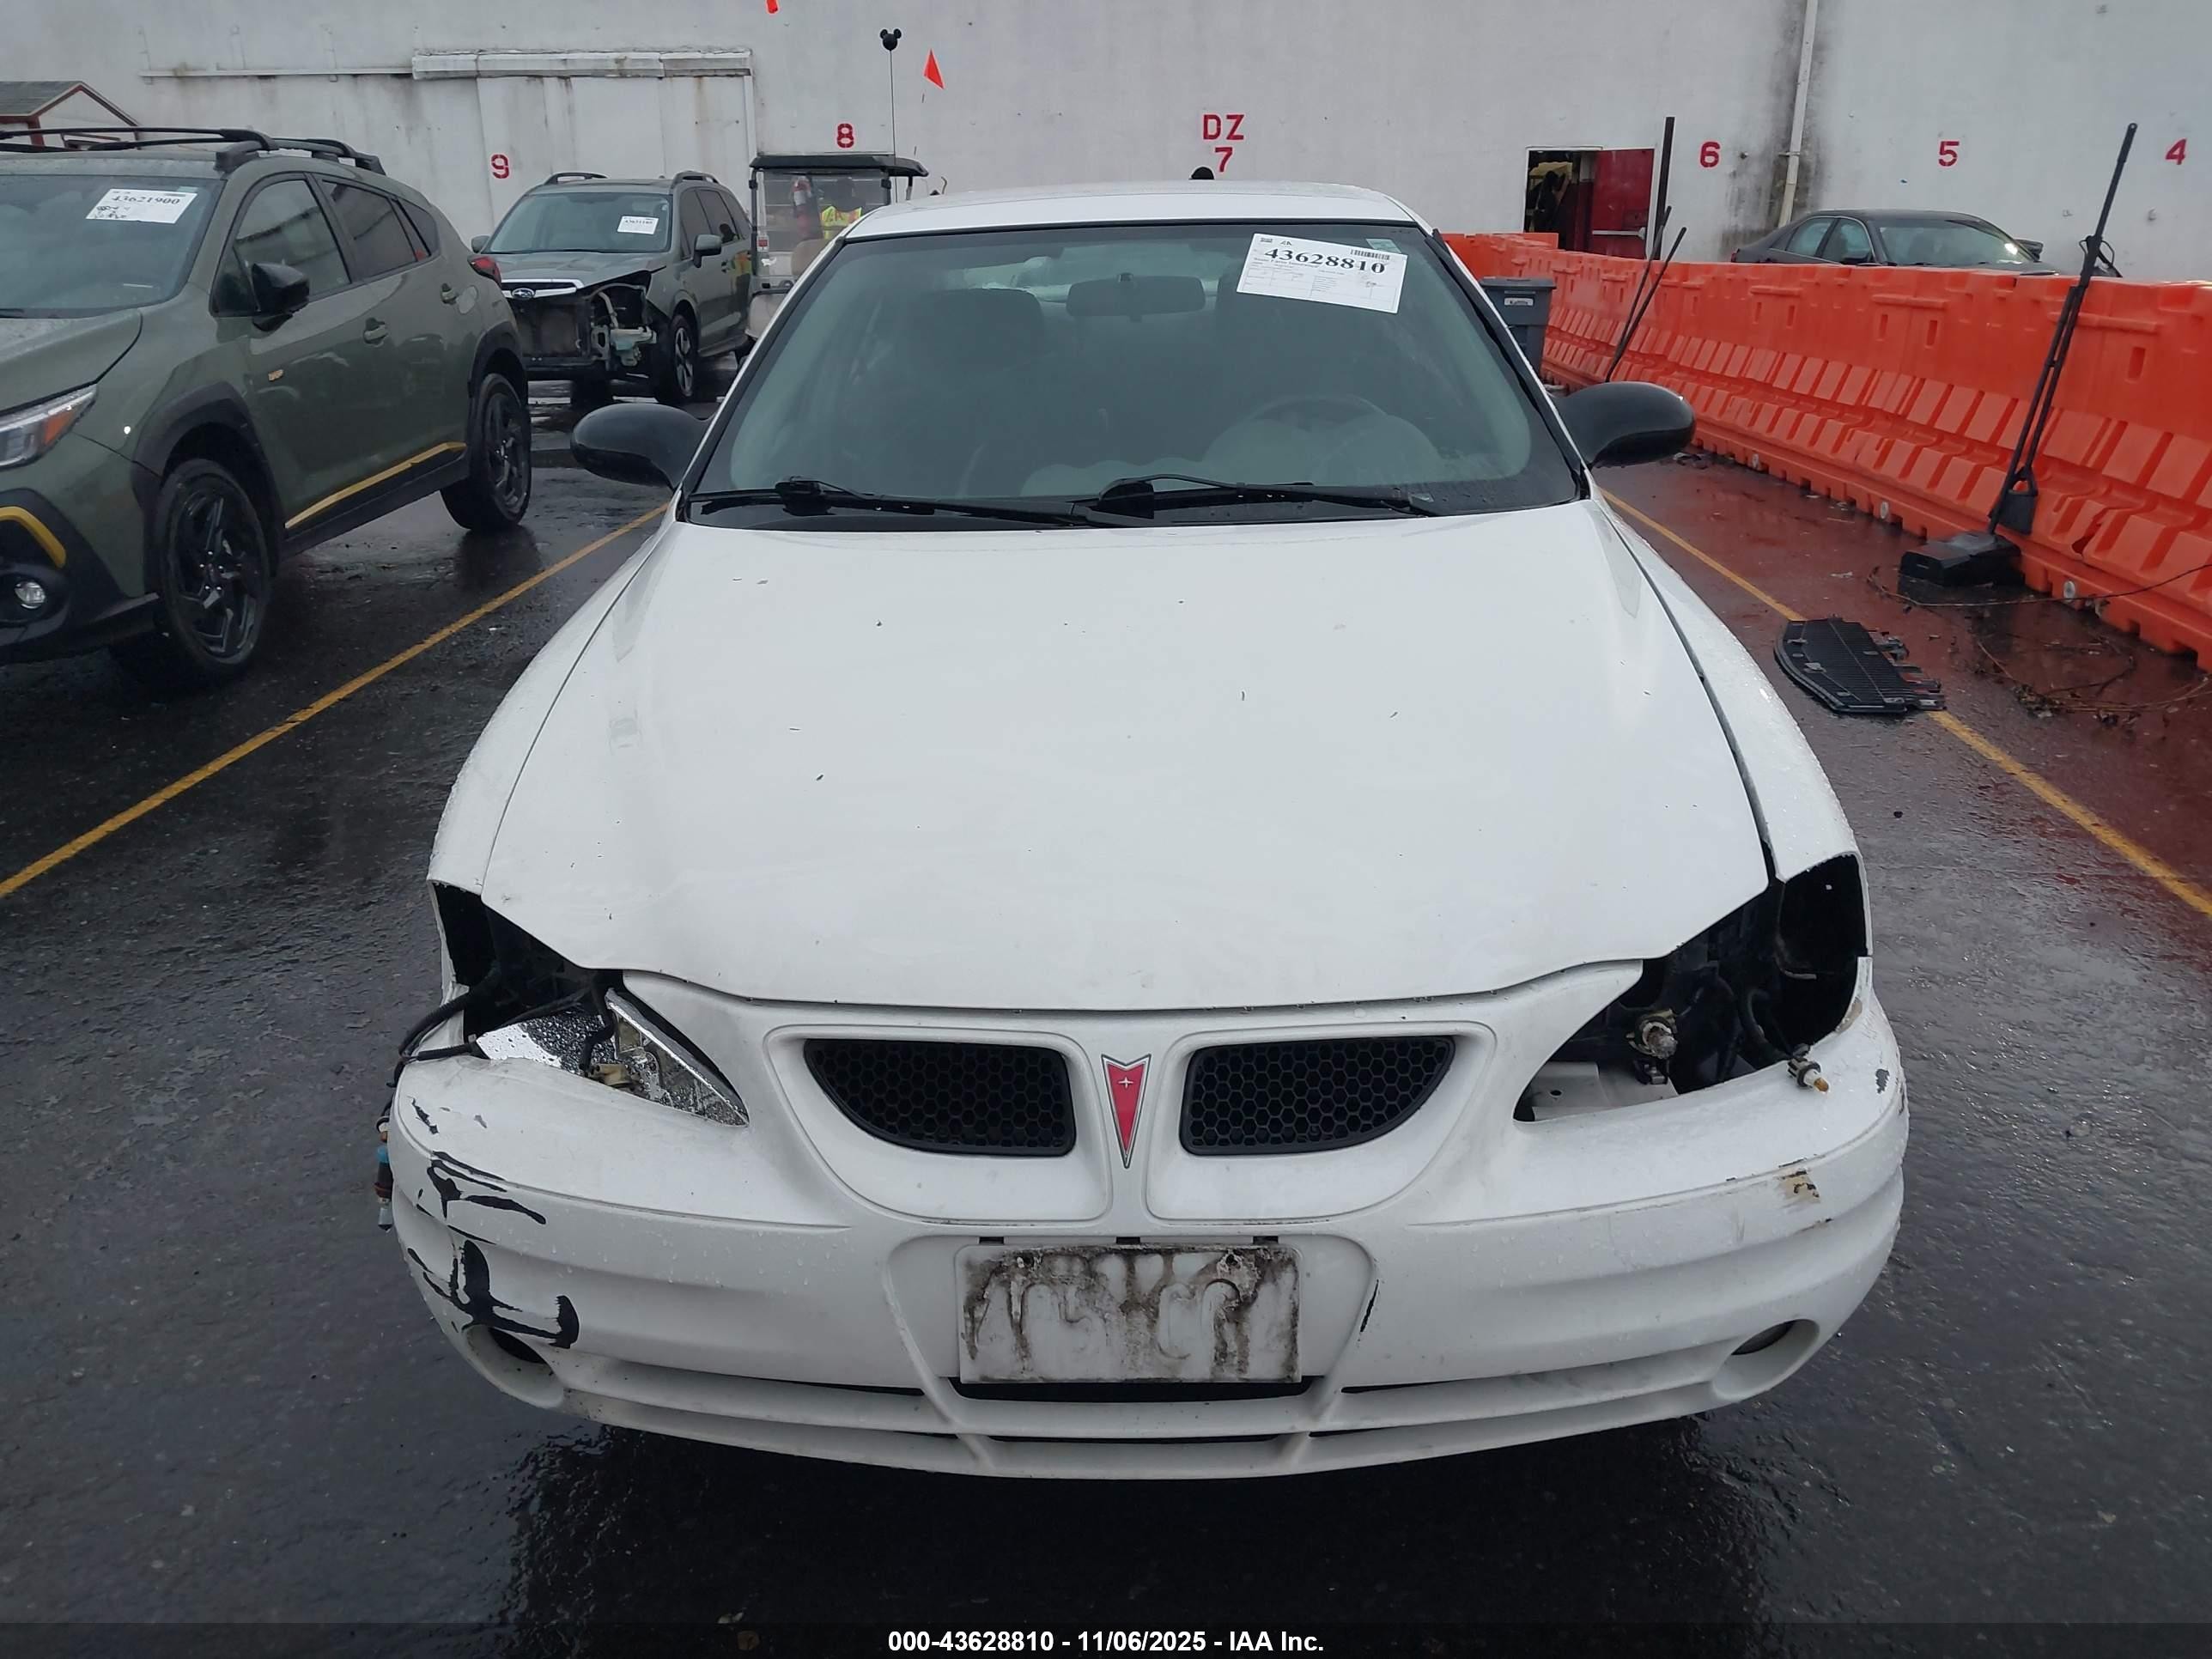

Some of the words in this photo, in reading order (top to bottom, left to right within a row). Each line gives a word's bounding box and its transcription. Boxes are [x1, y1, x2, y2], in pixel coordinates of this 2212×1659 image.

[836, 123, 854, 149] 8
[1201, 112, 1243, 142] DZ
[1214, 145, 1234, 173] 7
[1699, 140, 1721, 168] 6
[1938, 140, 1960, 167] 5
[2166, 138, 2187, 165] 4
[492, 154, 510, 179] 9
[1264, 247, 1386, 274] 43628810
